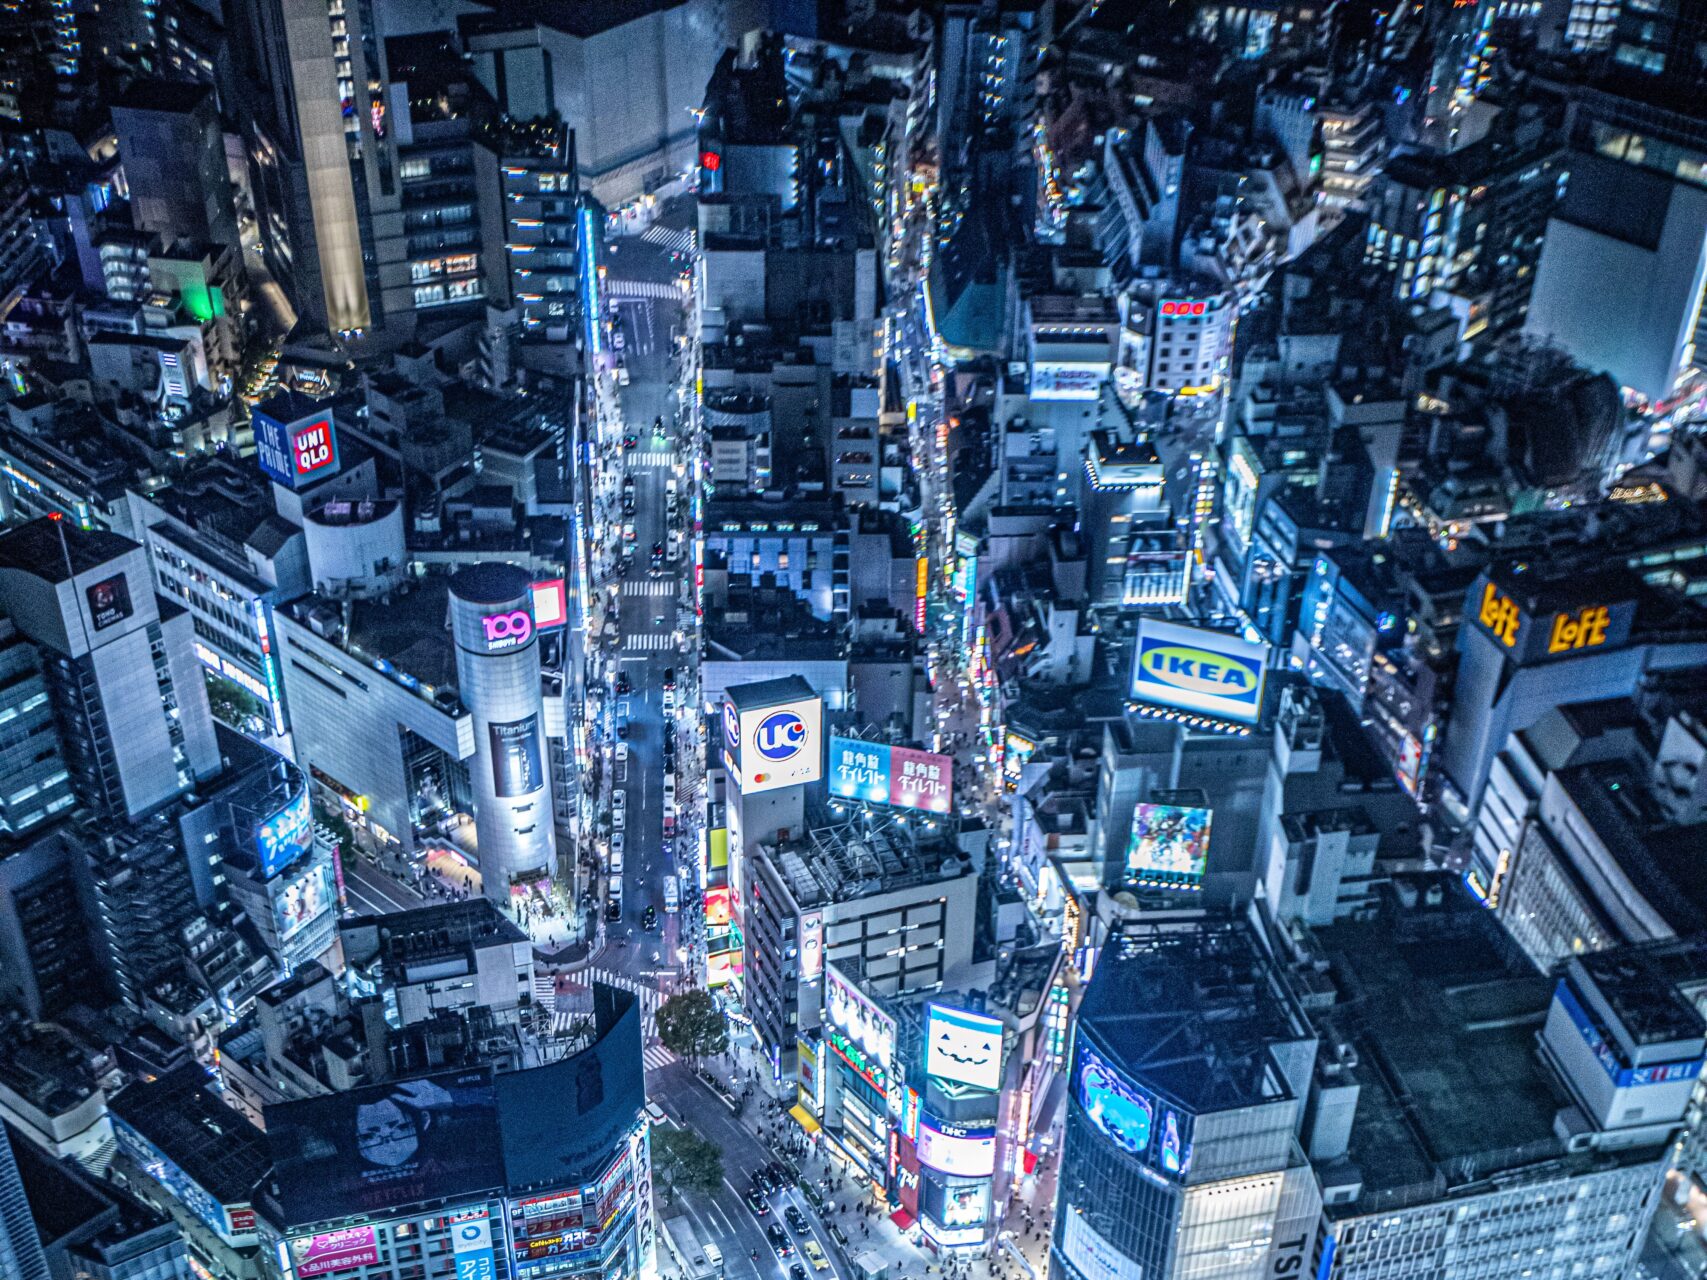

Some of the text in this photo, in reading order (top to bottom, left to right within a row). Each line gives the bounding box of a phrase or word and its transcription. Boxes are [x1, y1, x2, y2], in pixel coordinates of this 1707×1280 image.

[260, 420, 281, 450] THE
[298, 428, 324, 451] UNI
[258, 440, 291, 478] PRIME
[300, 445, 329, 469] QLO
[97, 608, 116, 621] TOHO
[483, 610, 531, 645] 109
[1152, 653, 1248, 689] IKEA
[493, 720, 536, 736] Titanium
[837, 765, 886, 785] ダイレクト
[897, 775, 946, 795] ダイレクト
[940, 1125, 968, 1138] DHC
[330, 1239, 367, 1251] クリニック
